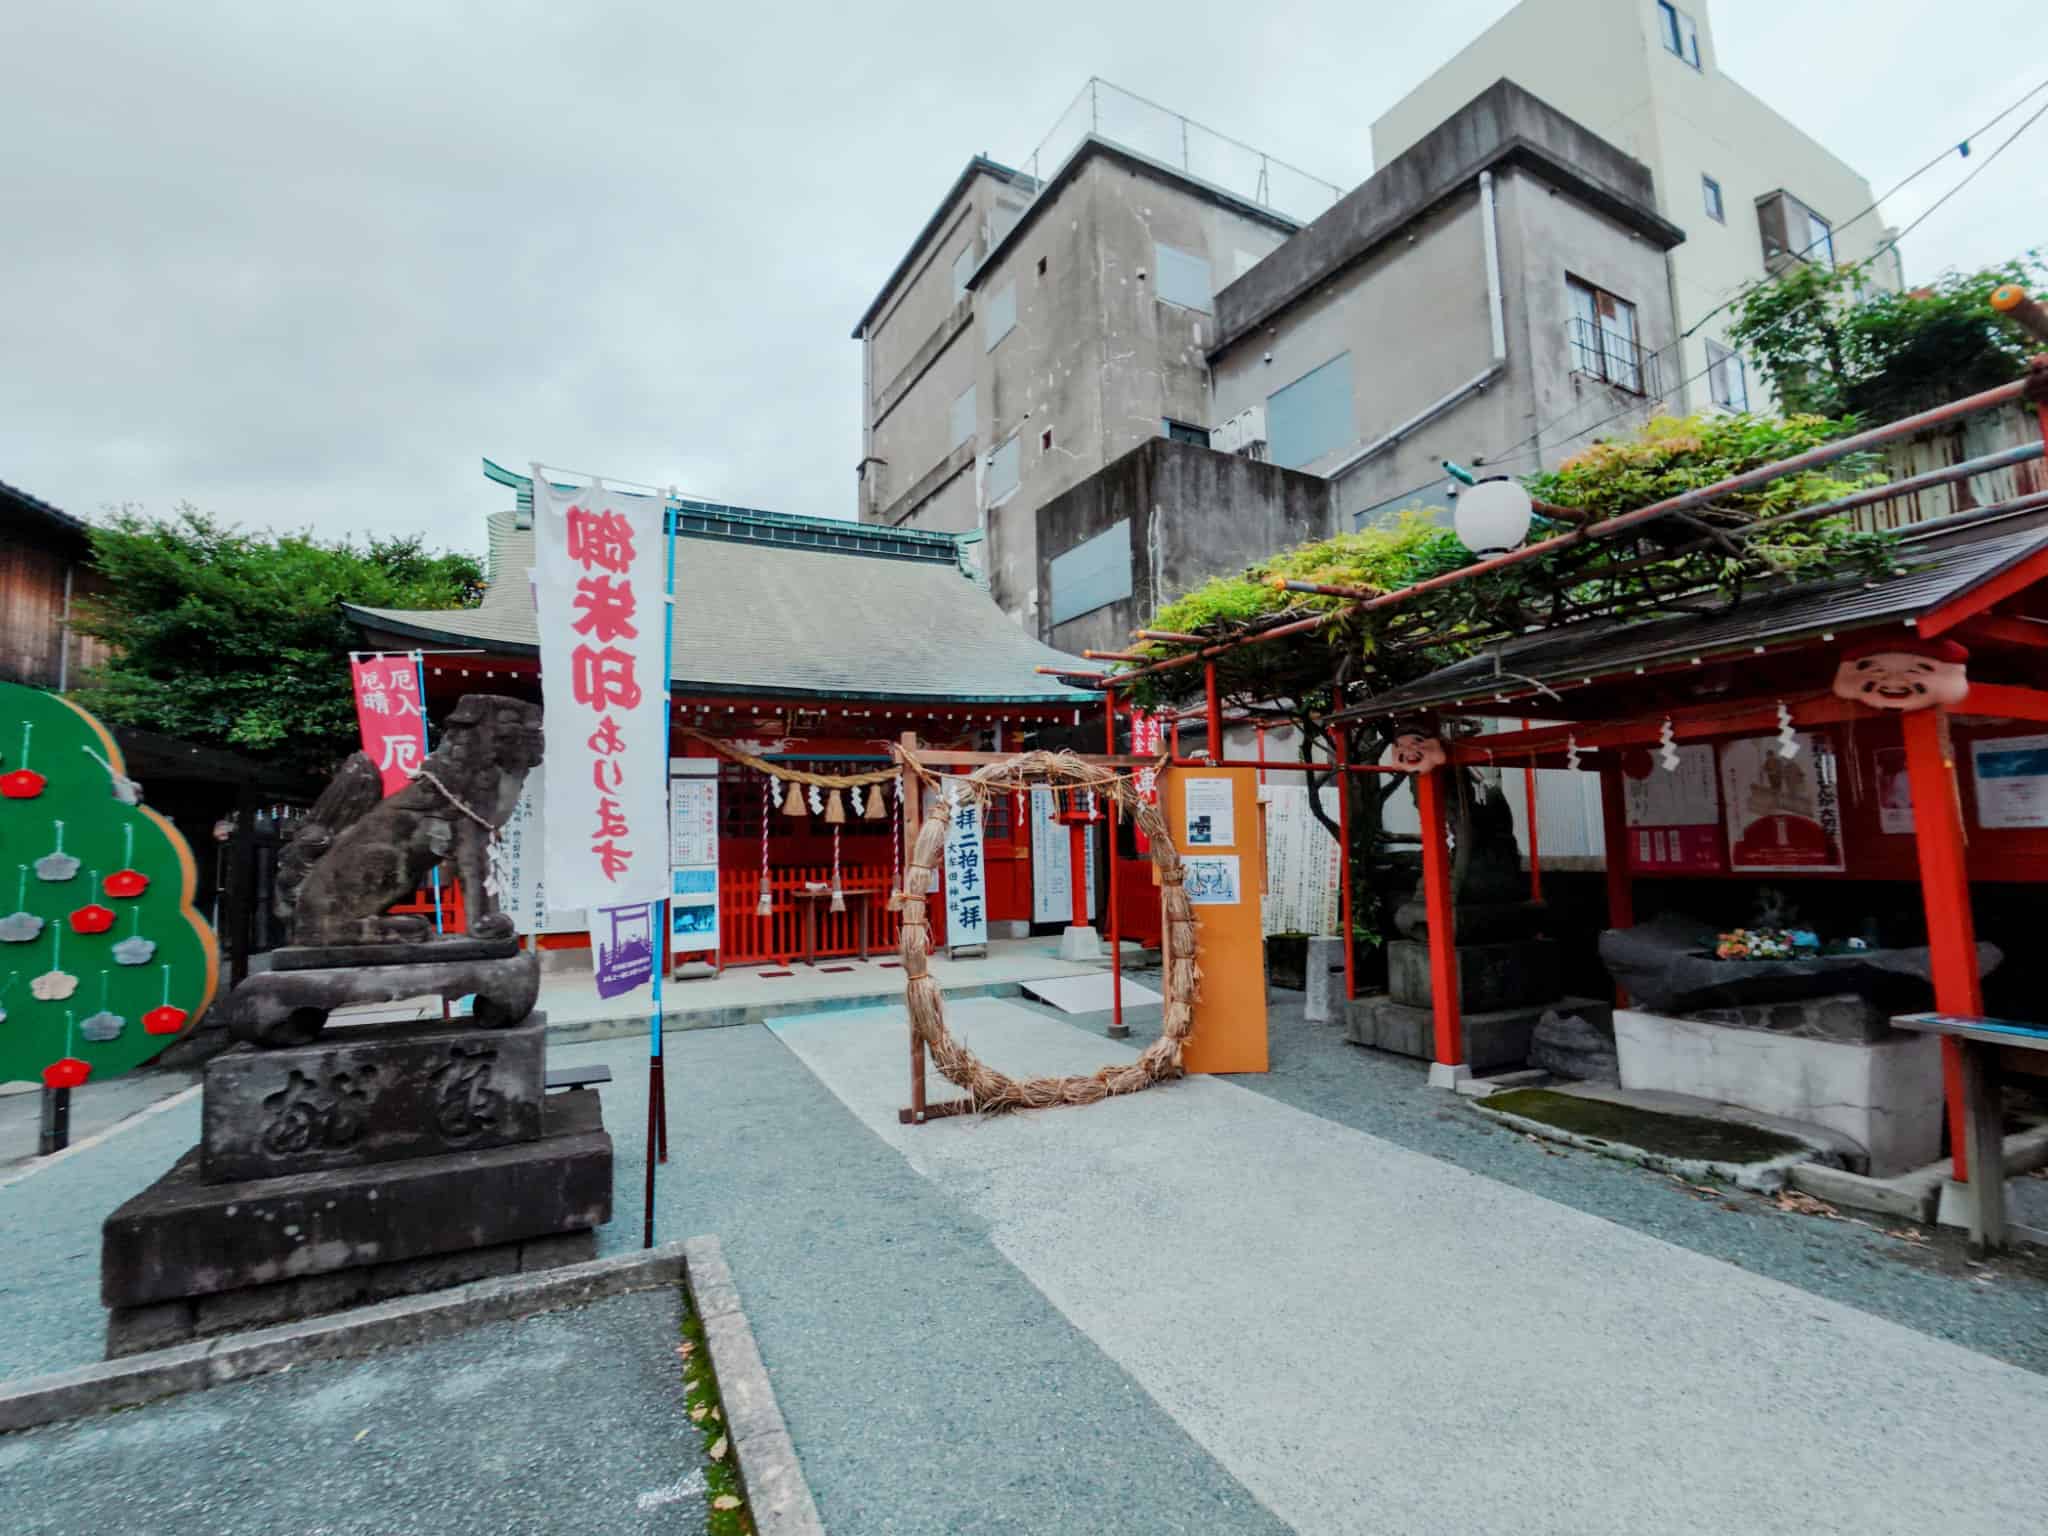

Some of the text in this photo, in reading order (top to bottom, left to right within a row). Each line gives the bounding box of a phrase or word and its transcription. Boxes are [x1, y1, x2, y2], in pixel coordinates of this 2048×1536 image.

[956, 801, 982, 930] 拝二拍手一拝
